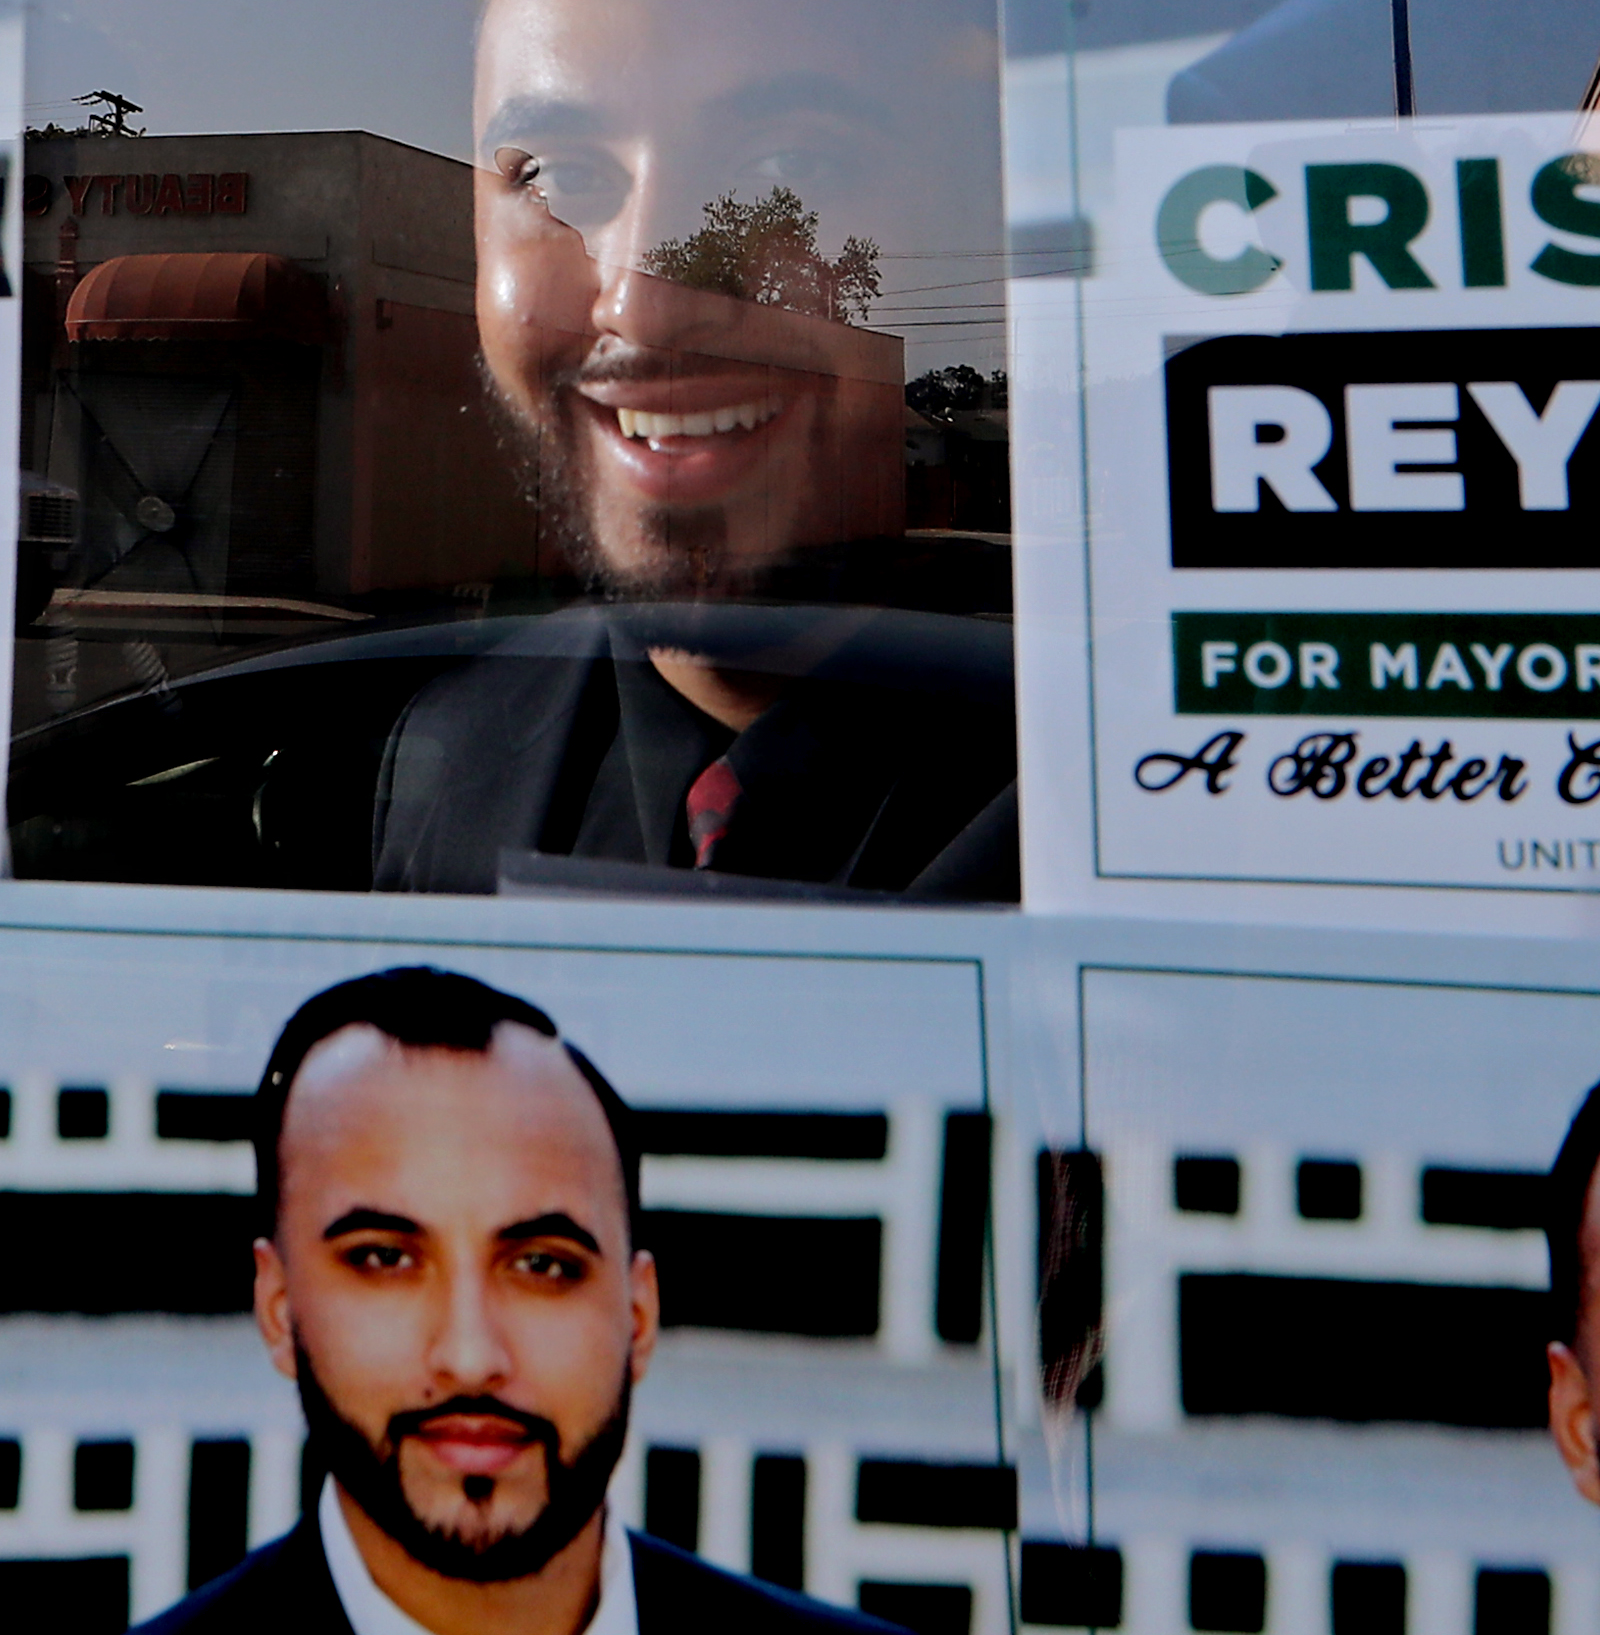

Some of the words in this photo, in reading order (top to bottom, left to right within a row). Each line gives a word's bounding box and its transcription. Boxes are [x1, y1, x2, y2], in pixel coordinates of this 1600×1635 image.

[1200, 639, 1340, 694] FOR
[1135, 728, 1232, 798] A
[1267, 731, 1527, 804] Better
